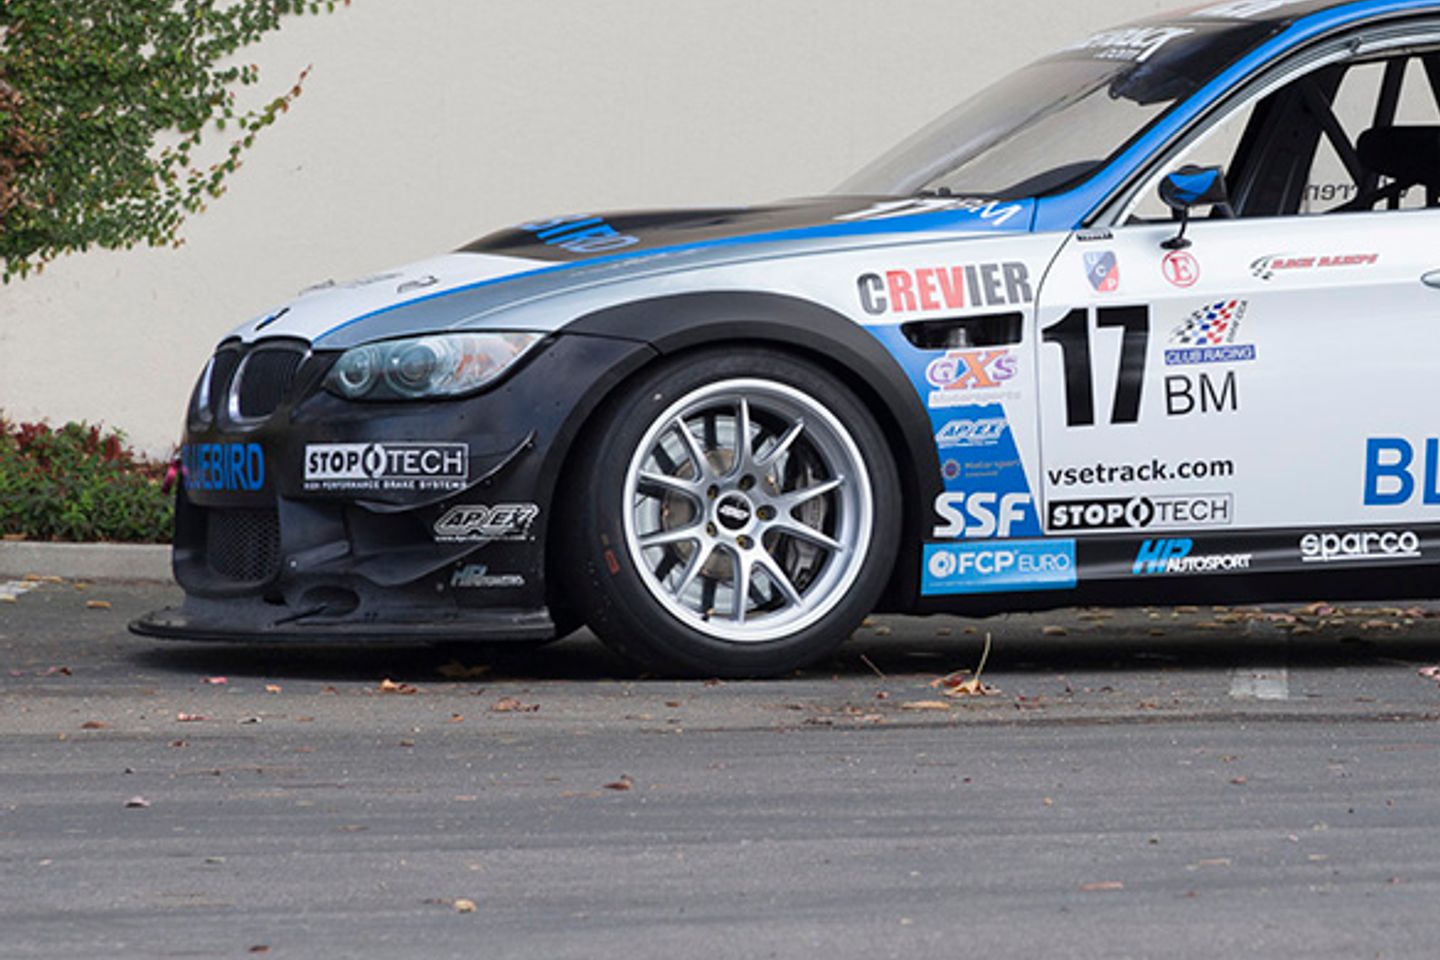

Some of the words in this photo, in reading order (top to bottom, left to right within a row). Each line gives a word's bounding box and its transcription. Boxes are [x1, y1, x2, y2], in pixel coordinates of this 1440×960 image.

[856, 261, 1033, 316] CREVIER
[1041, 304, 1150, 428] 17
[1166, 349, 1202, 365] CLUB
[1203, 346, 1253, 362] RACING
[1165, 371, 1239, 416] BM
[1048, 458, 1235, 487] vsetrack.com
[932, 492, 1031, 538] SSF
[958, 551, 1015, 574] FCP
[1018, 553, 1071, 573] EURO
[1131, 538, 1194, 575] HP
[1301, 531, 1420, 561] sparco
[1165, 553, 1253, 573] AUTOSPORT
